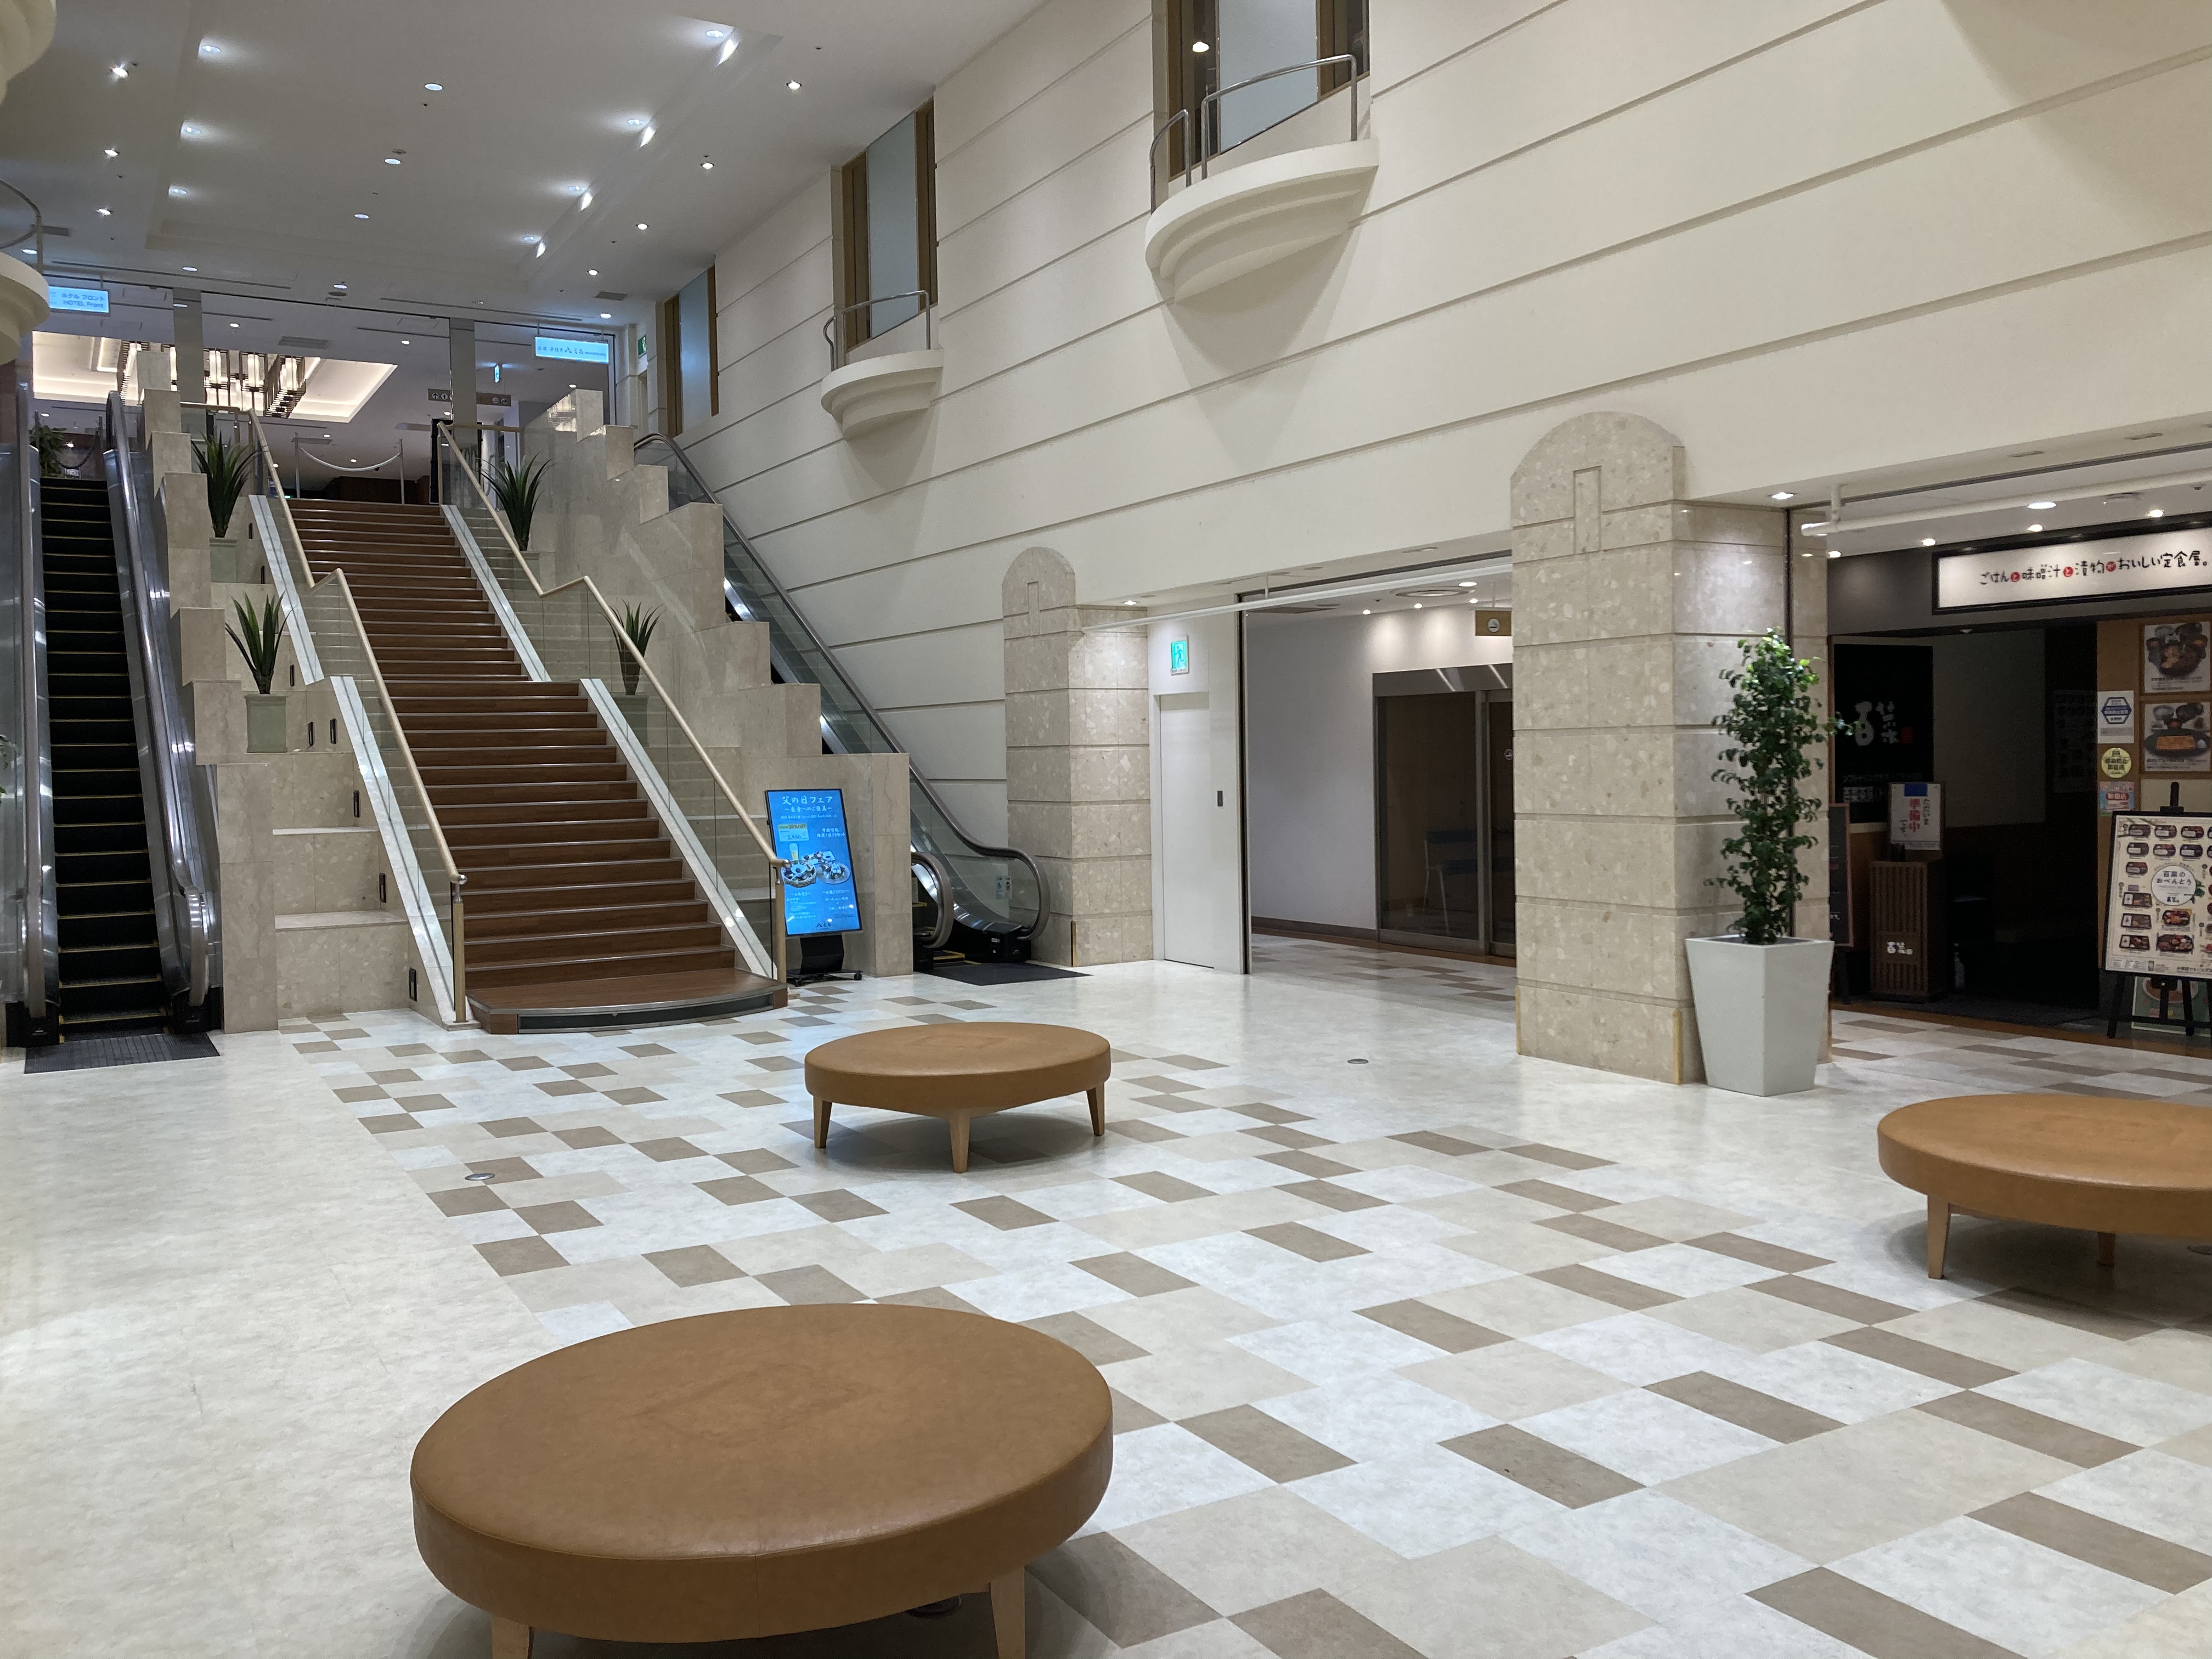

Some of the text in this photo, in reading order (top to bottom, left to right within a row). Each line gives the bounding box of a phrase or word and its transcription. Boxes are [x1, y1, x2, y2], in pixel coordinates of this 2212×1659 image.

[782, 795, 833, 805] 父の日フェア
[1909, 798, 1921, 833] 準備中
[2156, 878, 2192, 886] おべんとう
